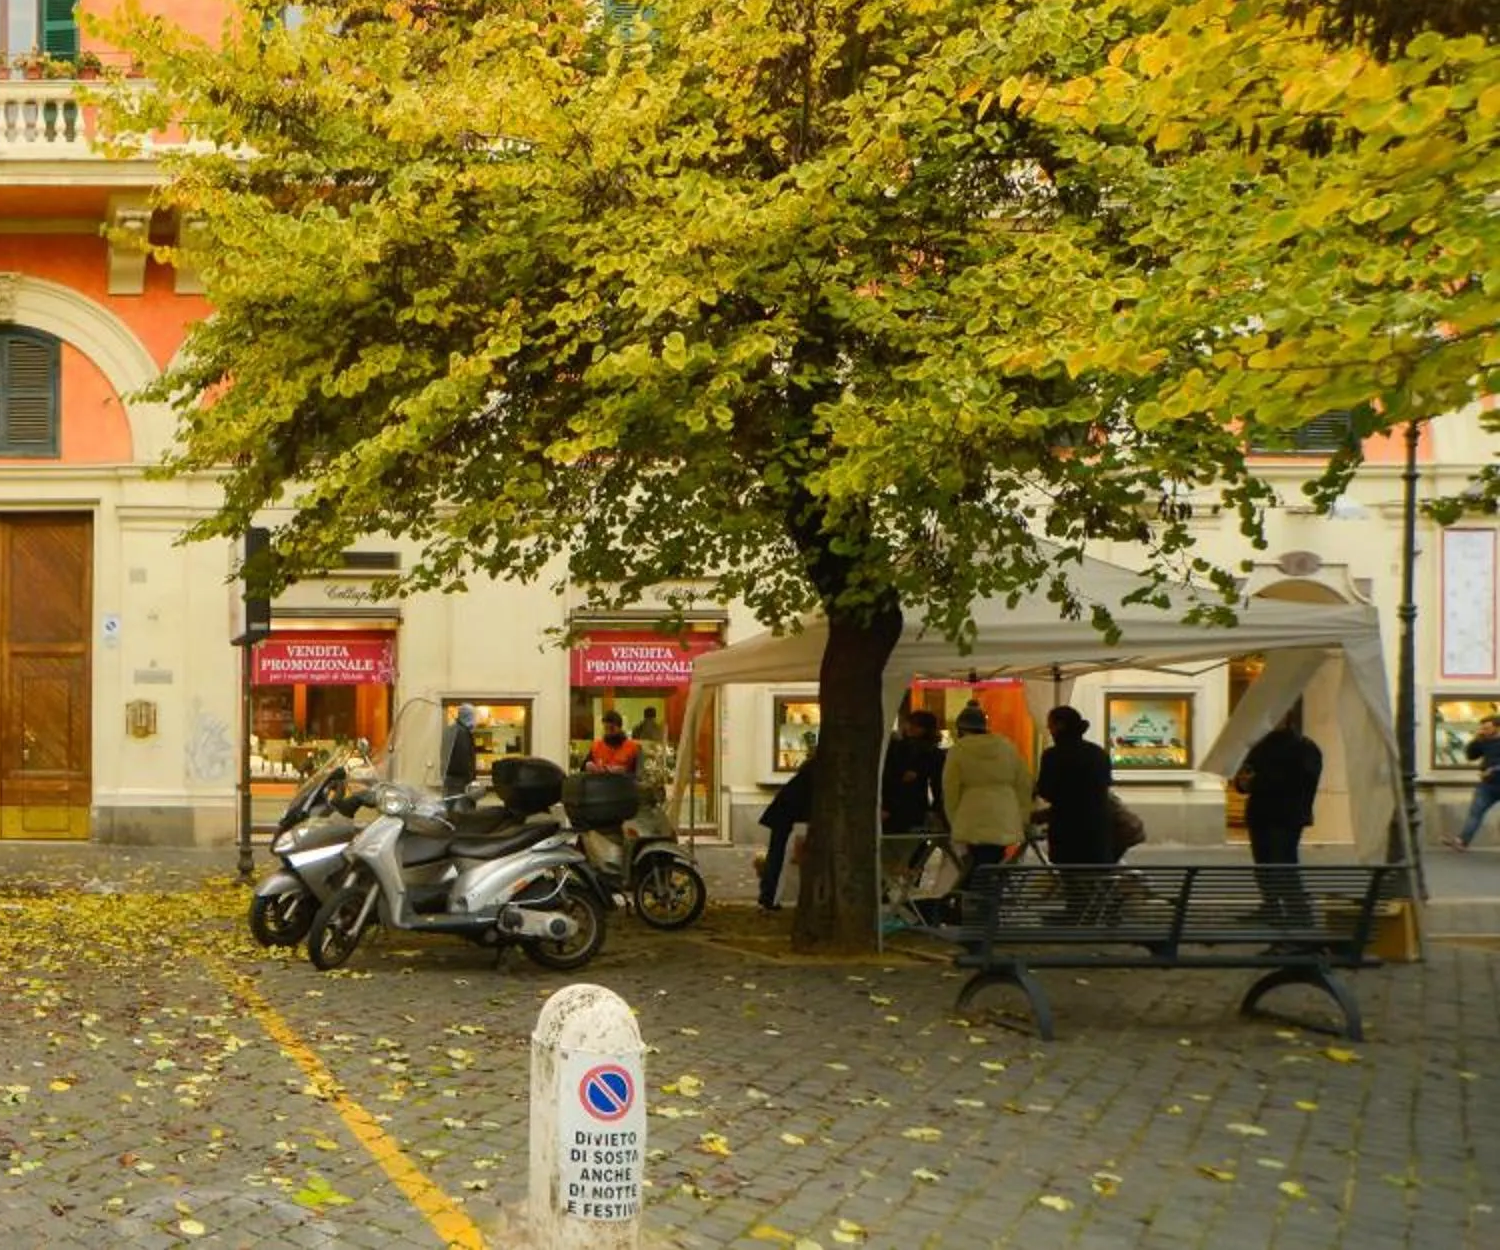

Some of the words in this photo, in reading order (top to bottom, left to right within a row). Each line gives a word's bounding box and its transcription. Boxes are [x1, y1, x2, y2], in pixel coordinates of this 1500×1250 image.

[286, 645, 349, 657] VENDITA
[611, 647, 674, 659] VENDITA
[261, 658, 374, 671] PROMOZIONALE
[575, 1131, 637, 1146] DIVIETO
[571, 1149, 587, 1162] DI
[594, 1150, 639, 1164] SOSTA
[580, 1167, 632, 1182] ANCHE
[569, 1183, 585, 1198] DI
[592, 1184, 637, 1199] NOTTE
[568, 1200, 577, 1214] E
